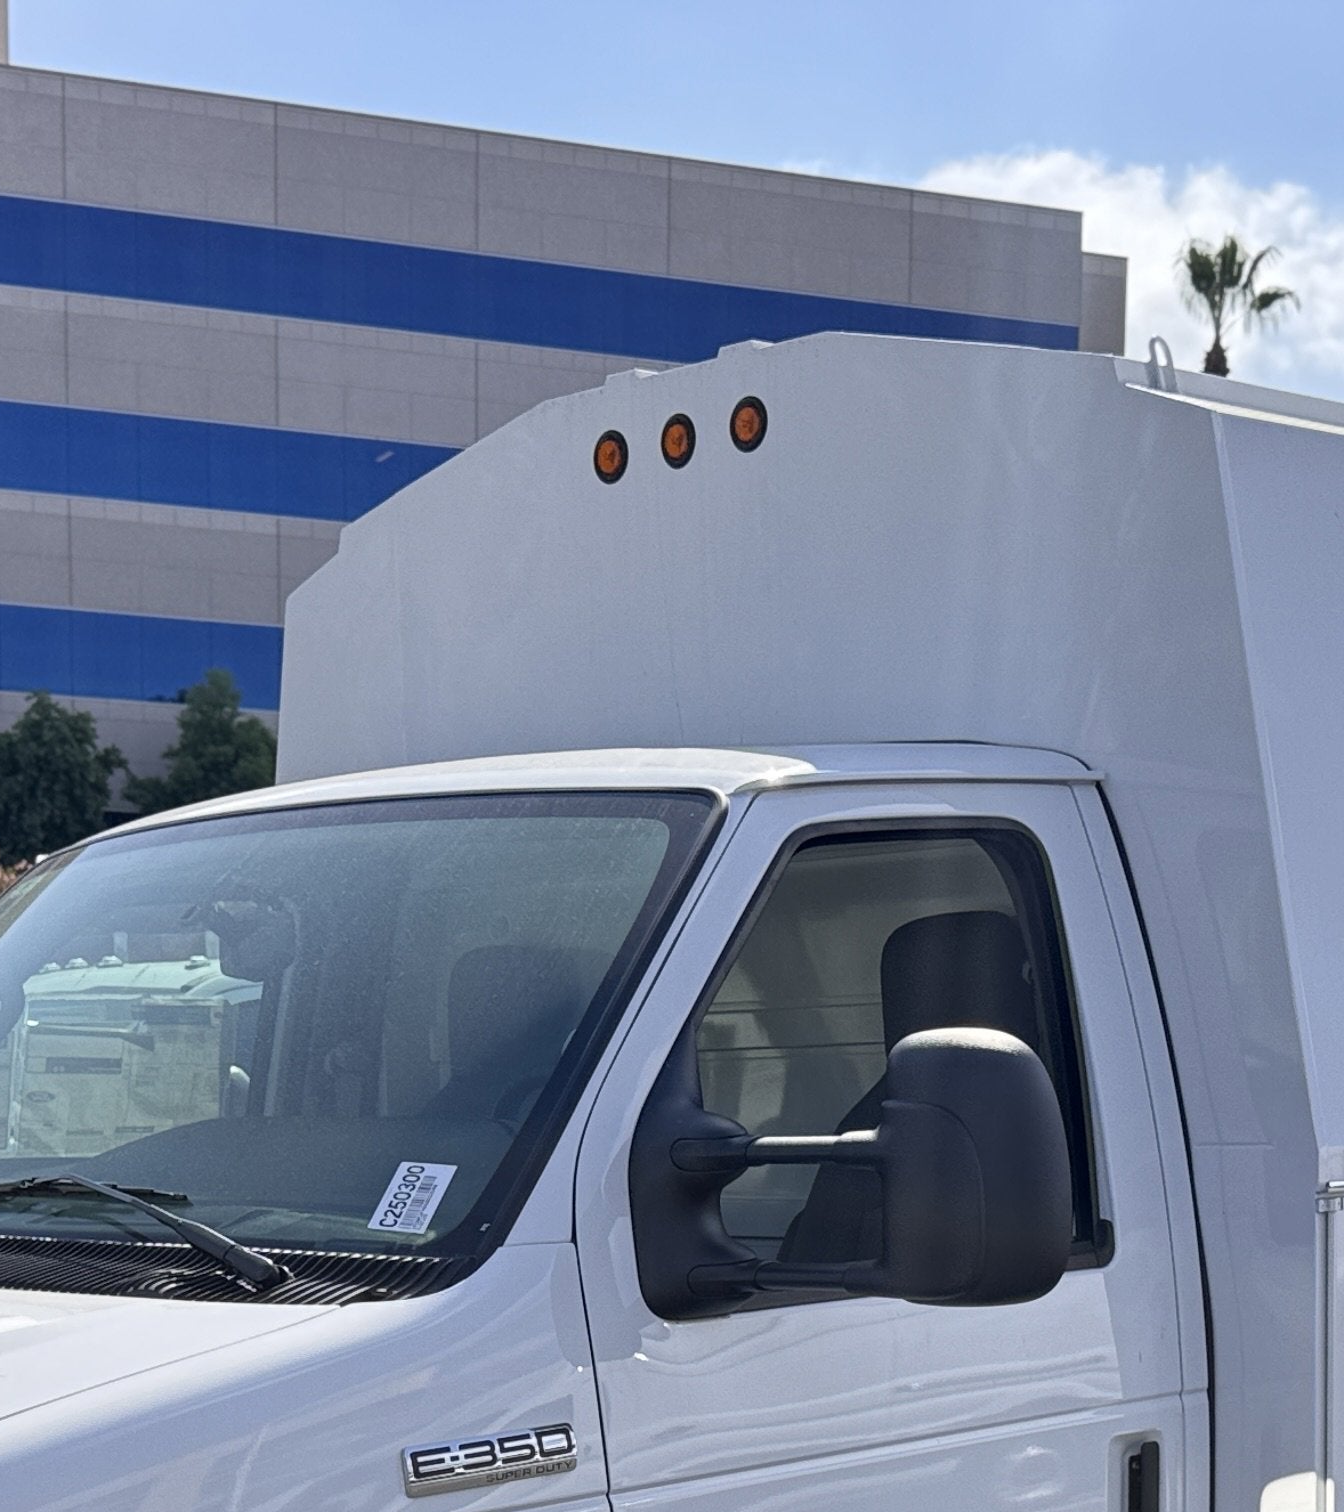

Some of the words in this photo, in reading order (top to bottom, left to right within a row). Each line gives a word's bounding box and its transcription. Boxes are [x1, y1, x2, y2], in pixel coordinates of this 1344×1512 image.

[378, 1164, 425, 1228] C250300
[409, 1426, 575, 1479] E-350
[485, 1466, 532, 1483] SUPER
[535, 1460, 573, 1475] DUTY
